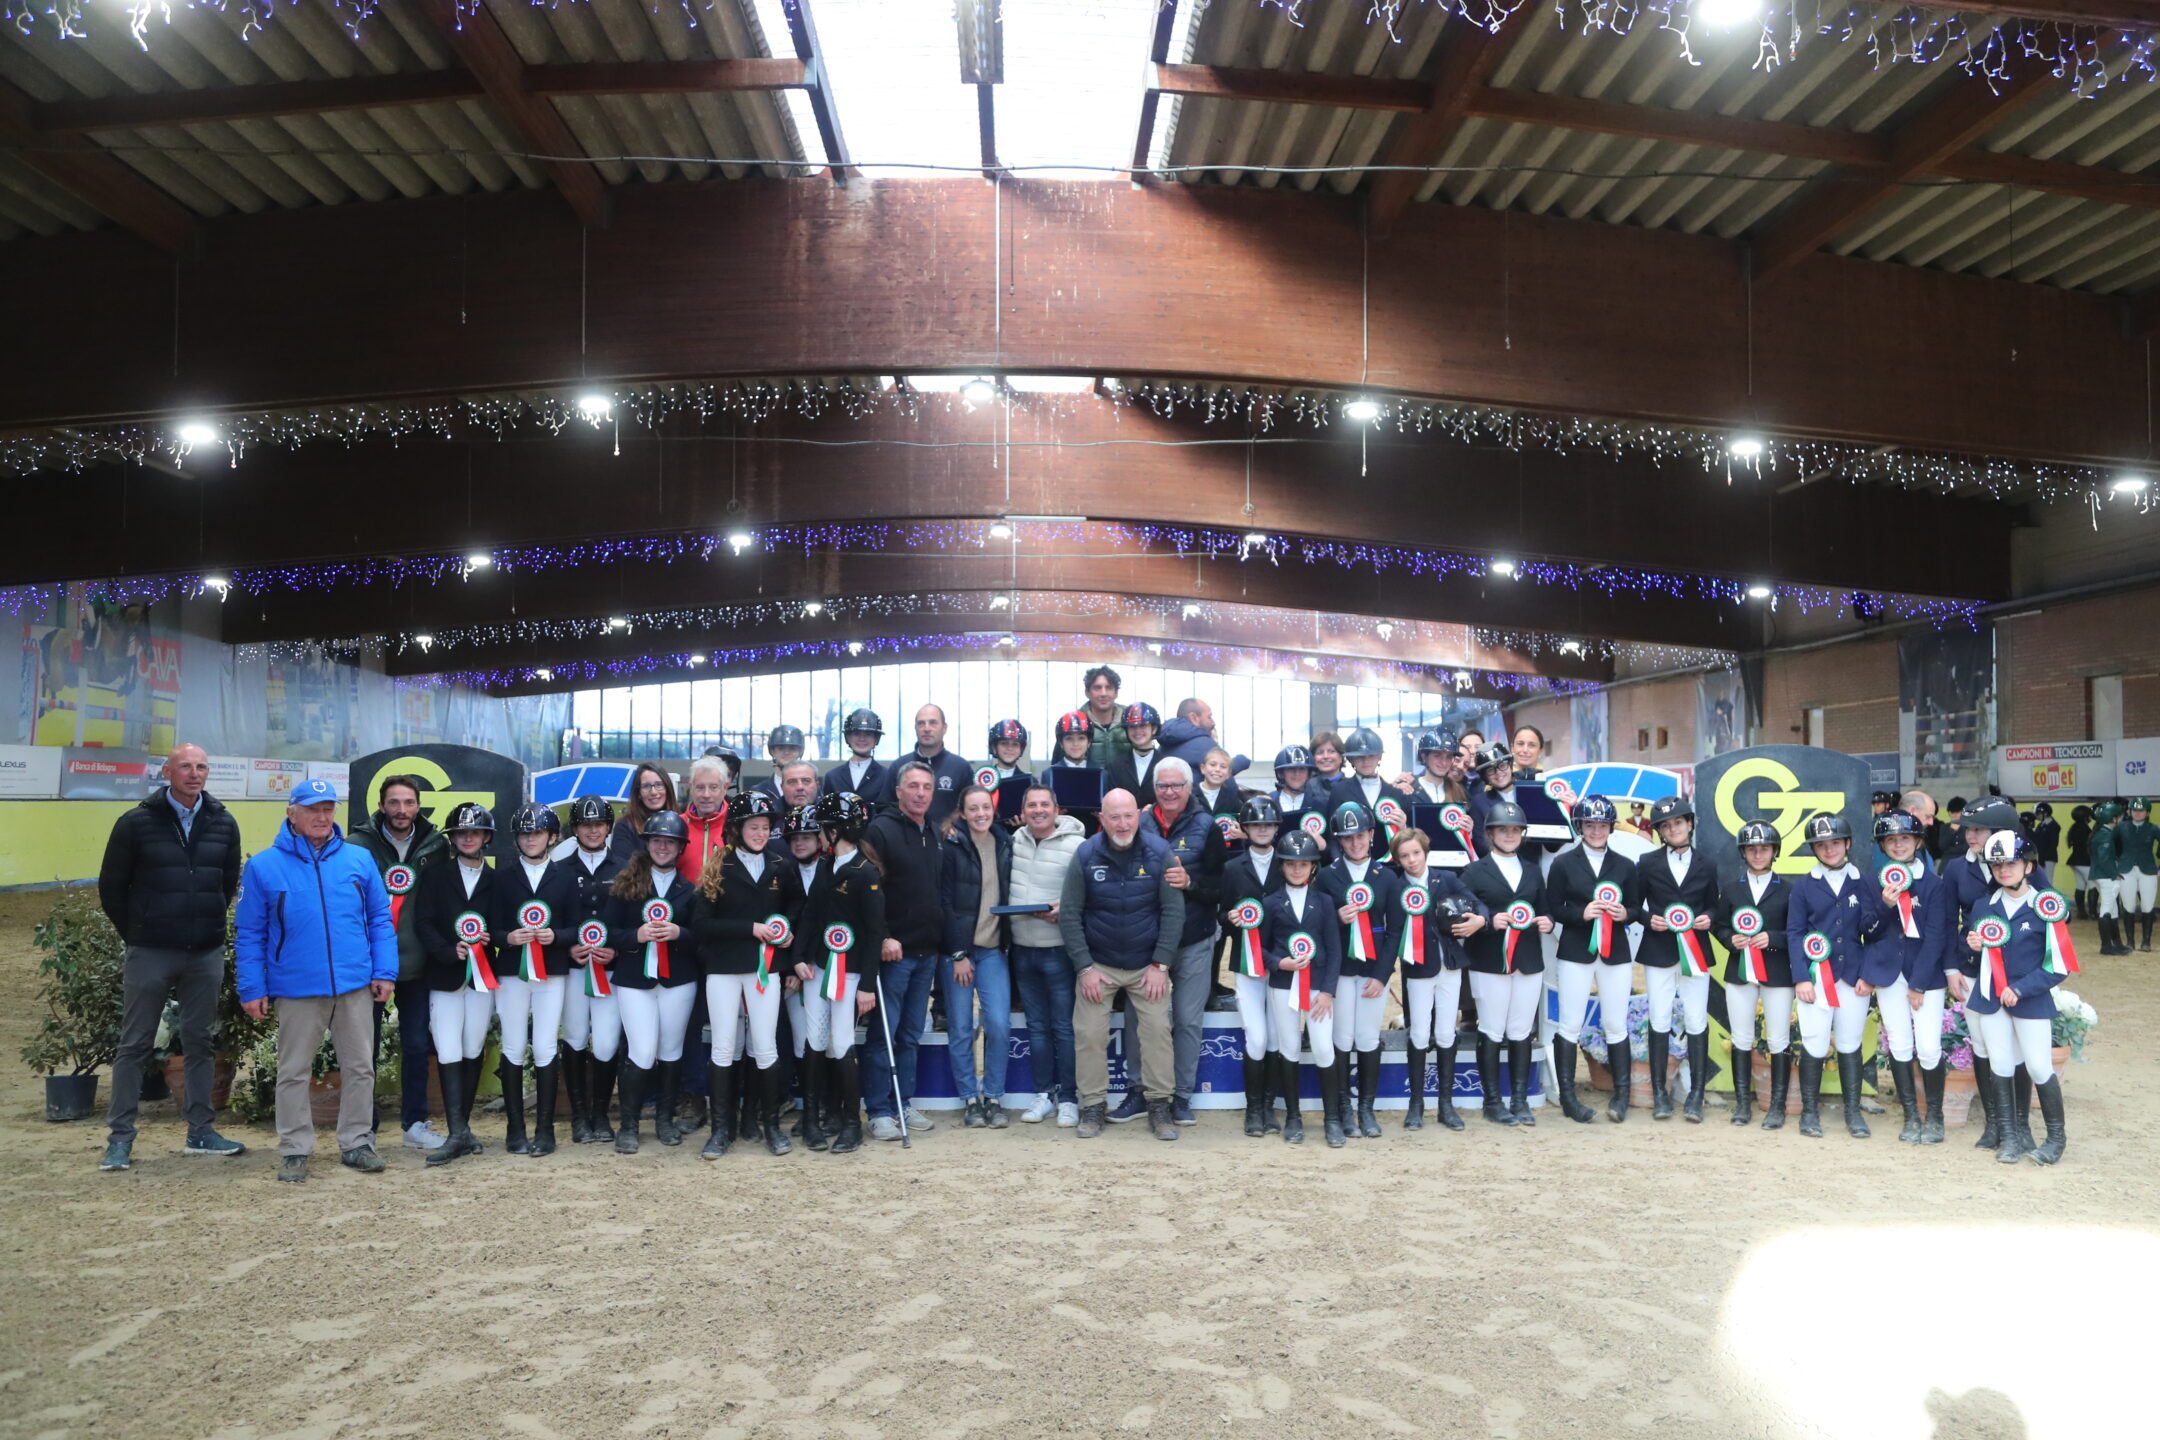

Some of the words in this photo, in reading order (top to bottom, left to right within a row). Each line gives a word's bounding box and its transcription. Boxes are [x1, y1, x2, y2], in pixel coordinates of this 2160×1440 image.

[2007, 748, 2042, 760] CAMPIONI
[2043, 747, 2052, 759] IN
[2055, 745, 2103, 758] TECNOLOGIA
[75, 761, 90, 770] Banca
[2034, 767, 2074, 787] comet
